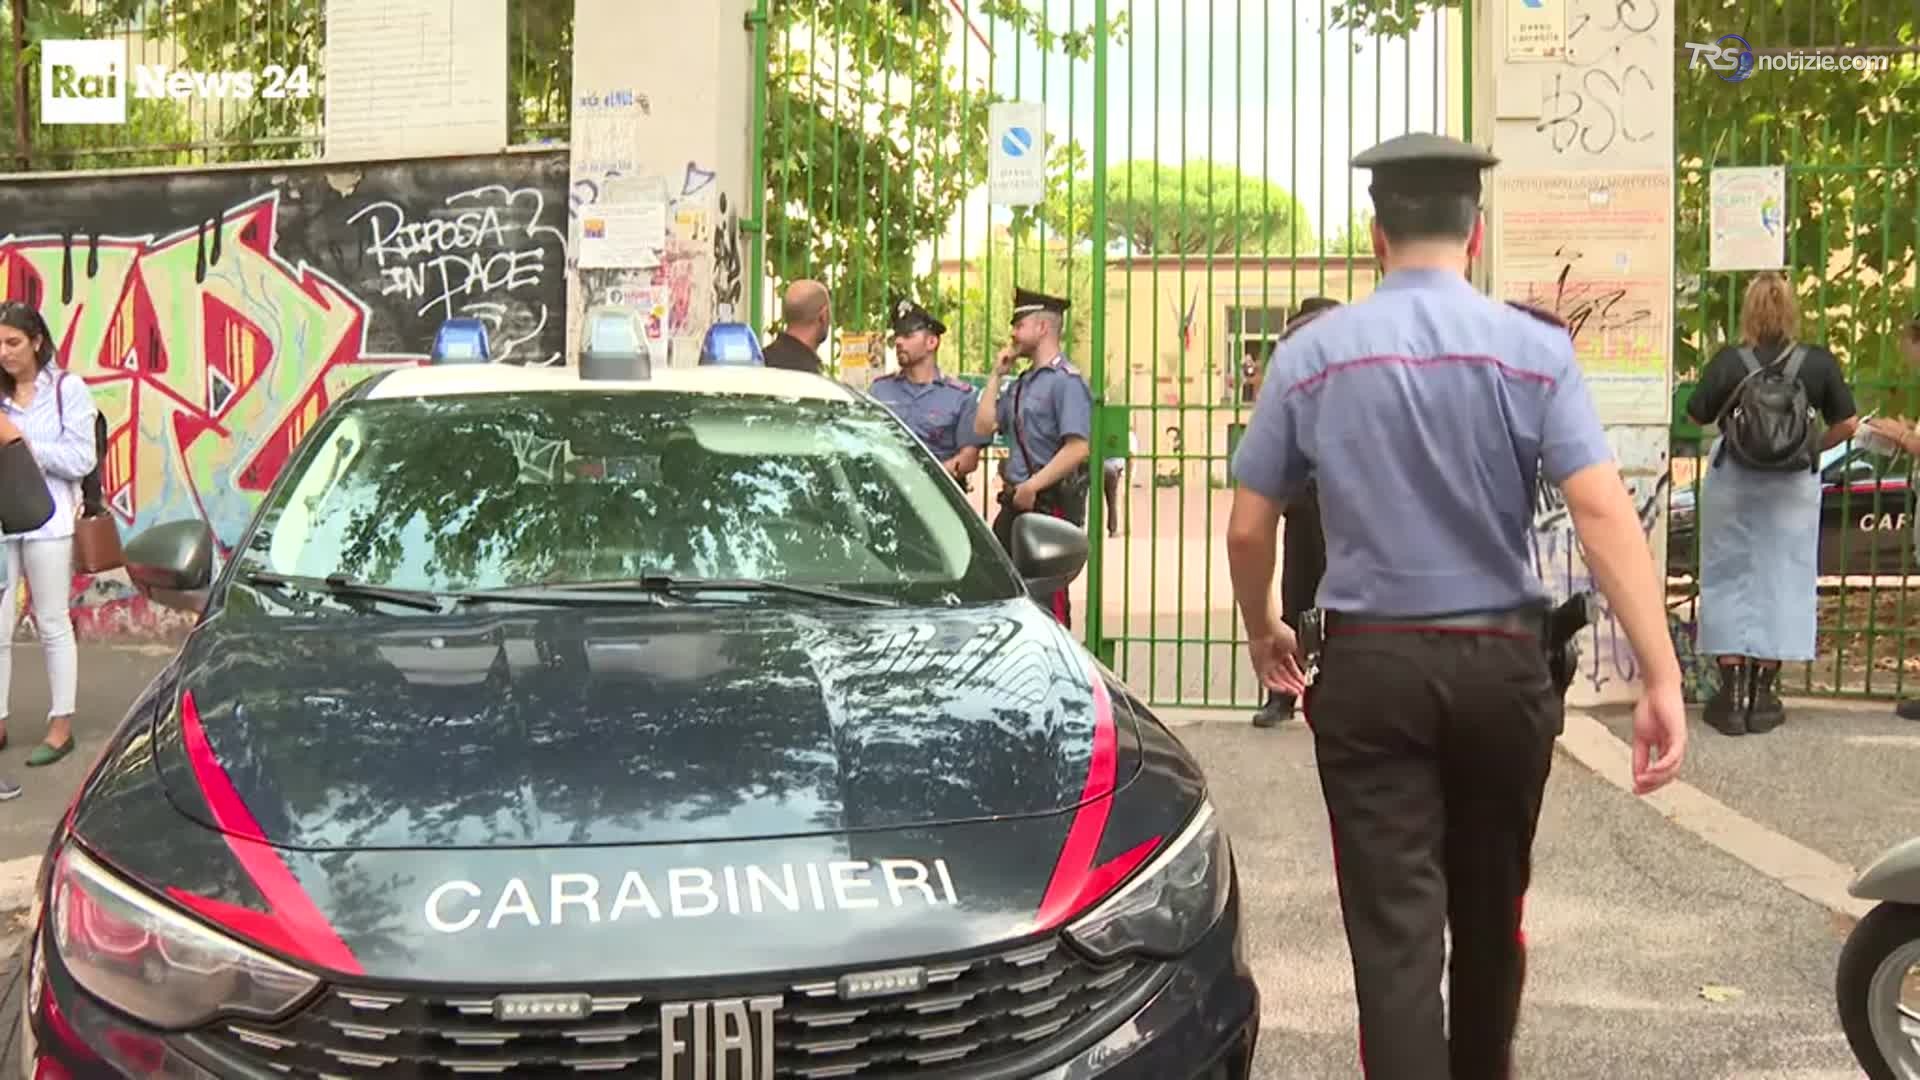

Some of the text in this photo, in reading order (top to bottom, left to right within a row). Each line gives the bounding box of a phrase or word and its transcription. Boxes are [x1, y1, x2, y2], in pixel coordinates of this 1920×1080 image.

[347, 201, 506, 266] RIPOSA
[380, 262, 425, 299] IN
[424, 858, 959, 933] CARABINIERI
[661, 994, 784, 1080] FIAT
